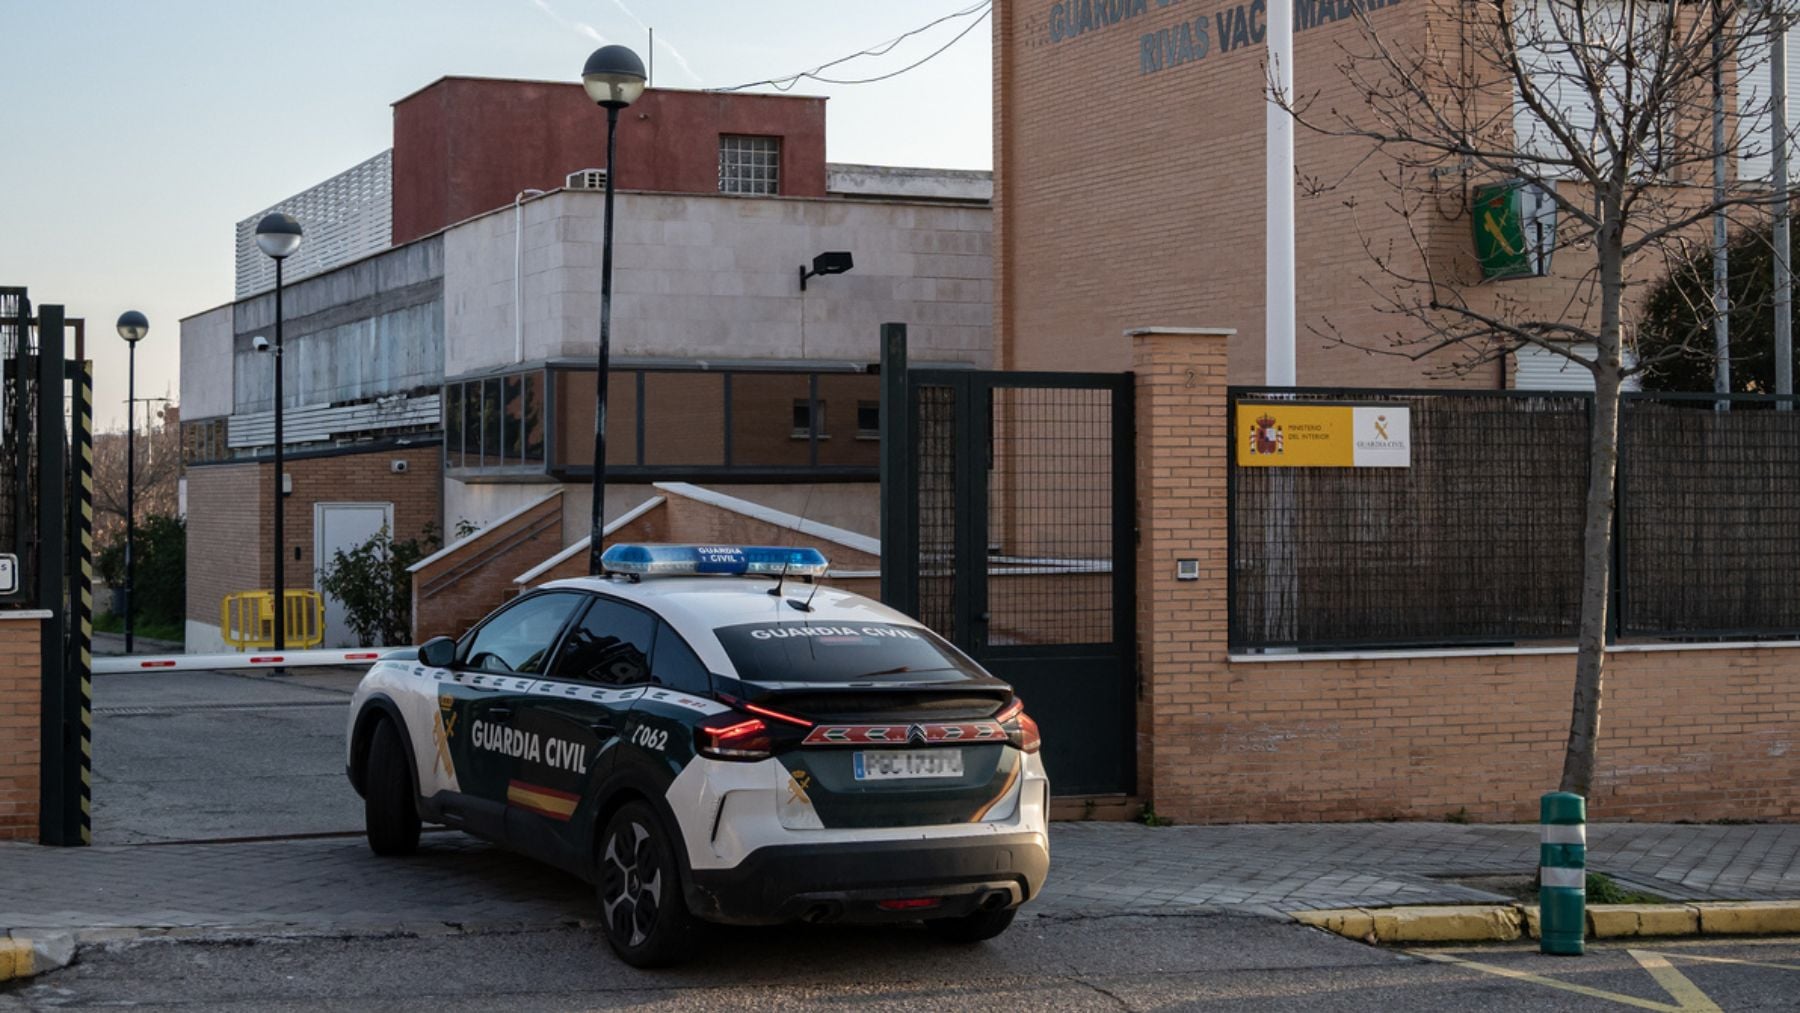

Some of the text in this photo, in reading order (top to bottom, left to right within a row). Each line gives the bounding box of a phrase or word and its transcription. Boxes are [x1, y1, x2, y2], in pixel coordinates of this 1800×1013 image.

[1138, 15, 1209, 76] RIVAS
[1184, 368, 1197, 388] 2
[1357, 441, 1386, 449] GUARDIA
[698, 547, 743, 555] GUARDIA
[710, 554, 738, 562] CIVIL
[751, 626, 920, 640] GUARDIA CIVIL
[471, 719, 587, 775] GUARDIA CIVIL
[640, 726, 668, 751] 062
